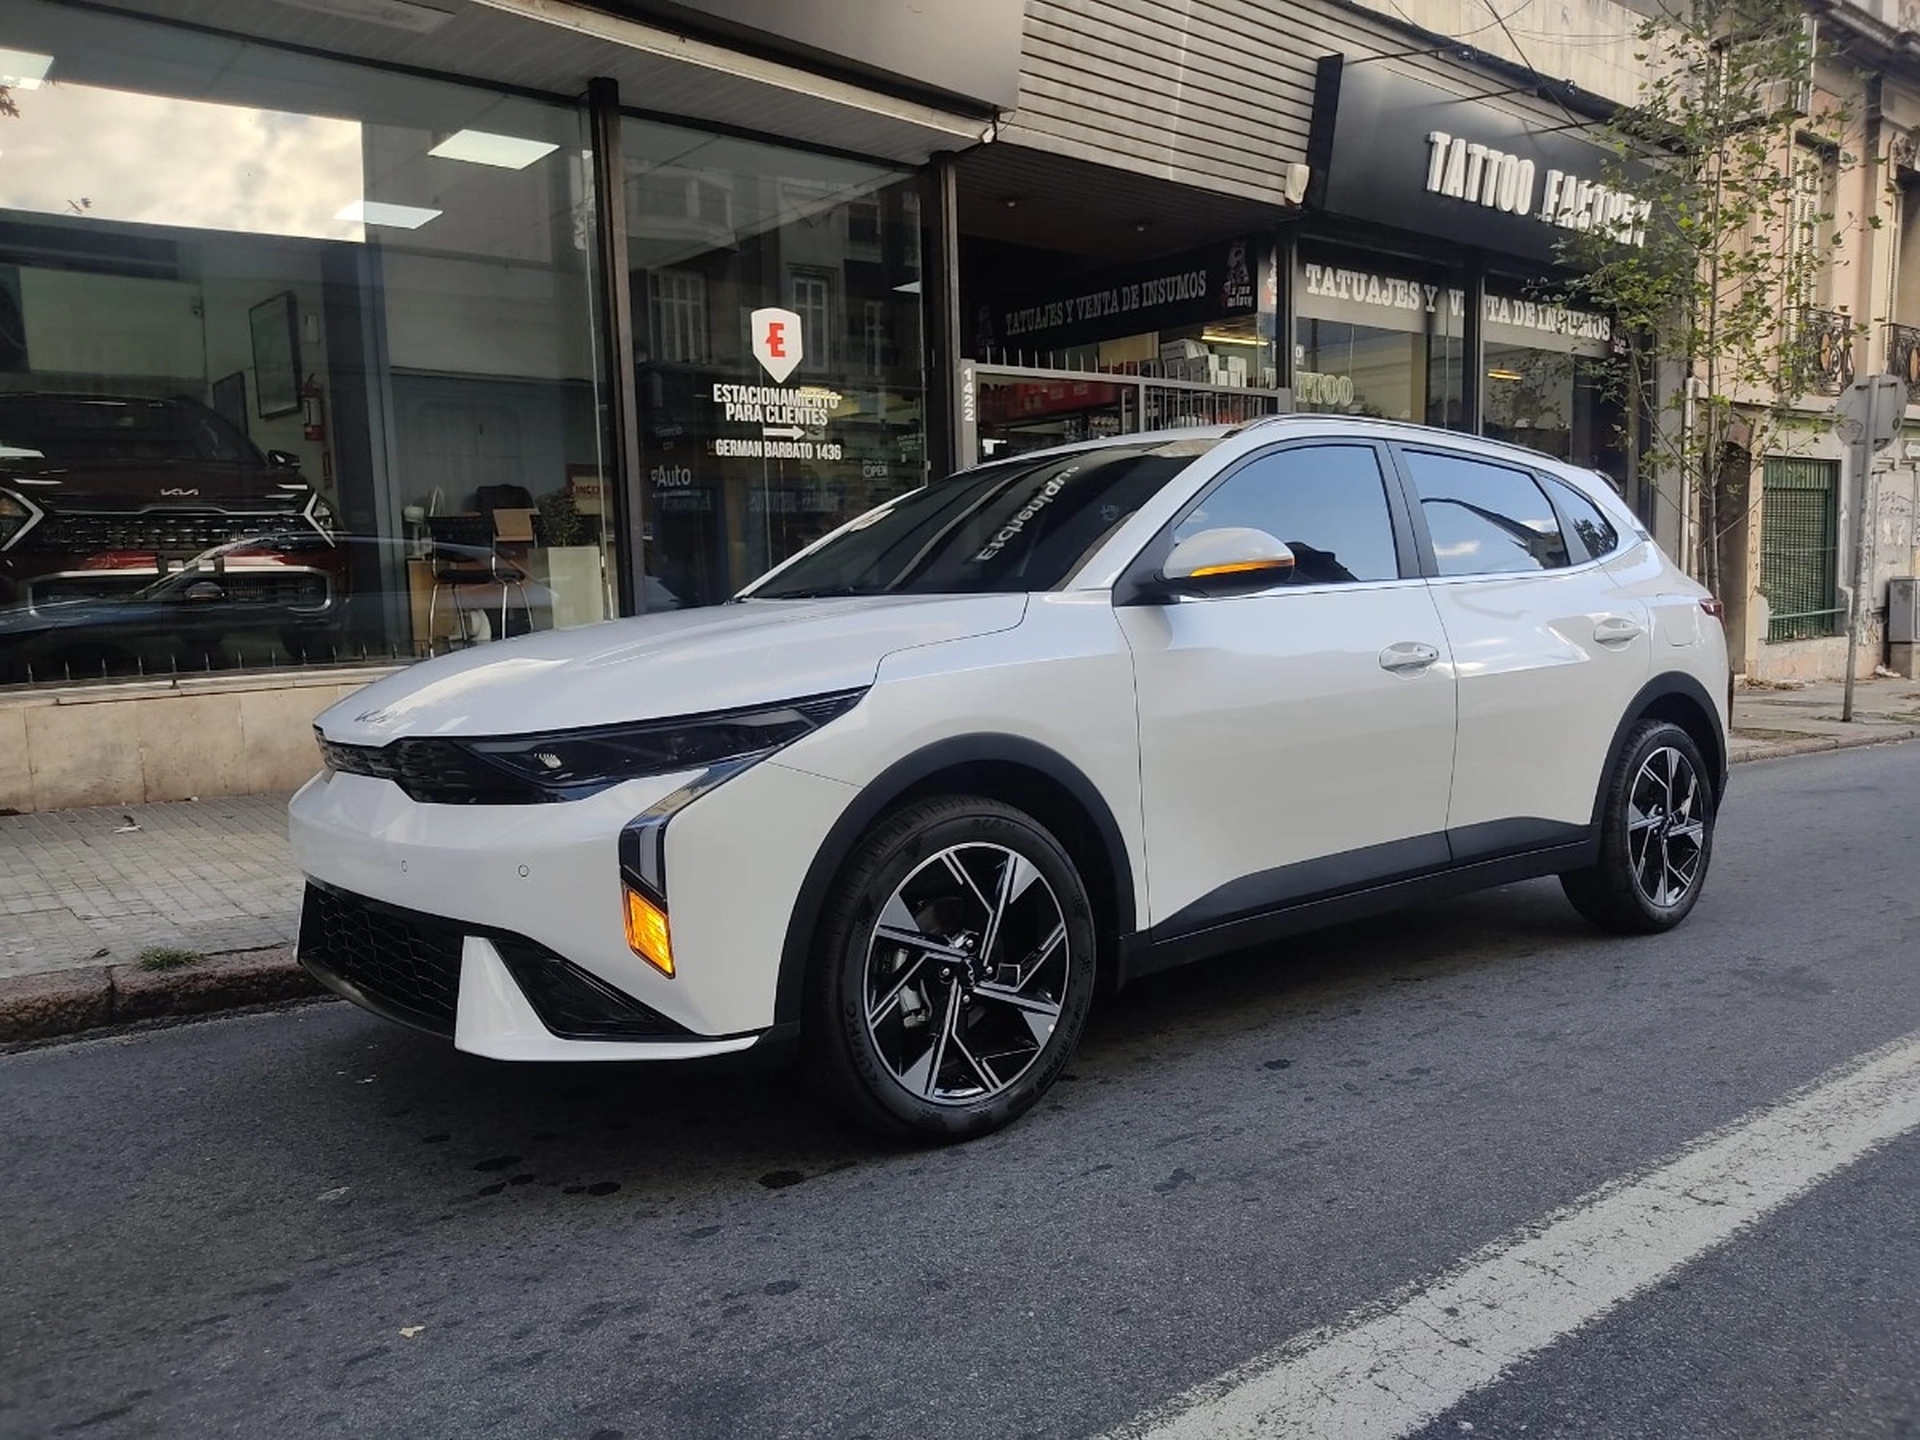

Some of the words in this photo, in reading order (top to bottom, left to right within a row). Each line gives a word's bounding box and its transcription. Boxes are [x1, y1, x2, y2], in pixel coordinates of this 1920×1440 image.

[1427, 131, 1535, 215] TATTOO
[1005, 301, 1064, 336] TATUAJES
[1066, 299, 1075, 323] Y
[1076, 289, 1120, 321] VENTA
[1121, 284, 1140, 311] DE
[1142, 270, 1207, 307] INSUMOS
[1305, 263, 1420, 311] TATUAJES
[1424, 284, 1438, 313] Y
[1512, 300, 1536, 328] DE
[713, 383, 839, 410] ESTACIONAMIENTO
[725, 402, 763, 422] PARA
[766, 405, 828, 426] CLIENTES
[963, 367, 974, 422] 1422
[715, 438, 763, 457] GERMAN
[764, 440, 813, 459] BARBATO
[815, 443, 841, 460] 1436
[159, 488, 200, 497] KIA
